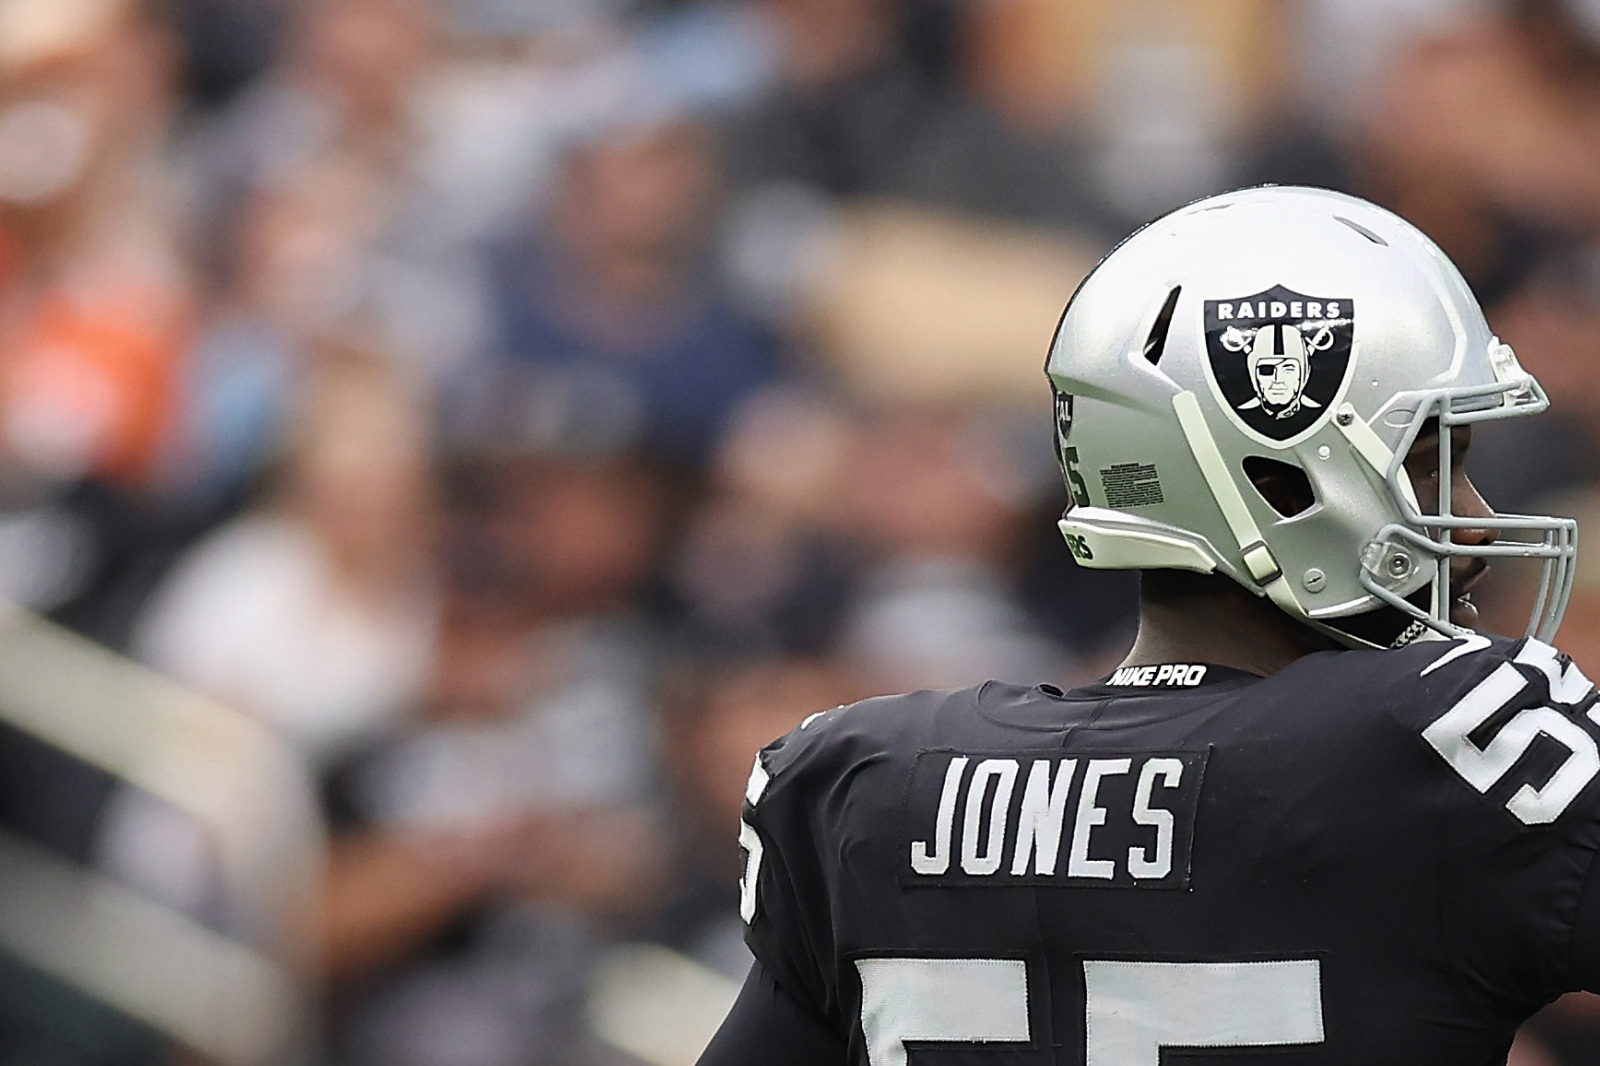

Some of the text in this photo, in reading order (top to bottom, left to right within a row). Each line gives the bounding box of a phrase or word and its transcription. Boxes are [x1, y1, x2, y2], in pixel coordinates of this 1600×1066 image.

[1217, 301, 1341, 320] RAIDERS
[1105, 664, 1208, 687] NIKE PRO
[911, 757, 1184, 881] JONES
